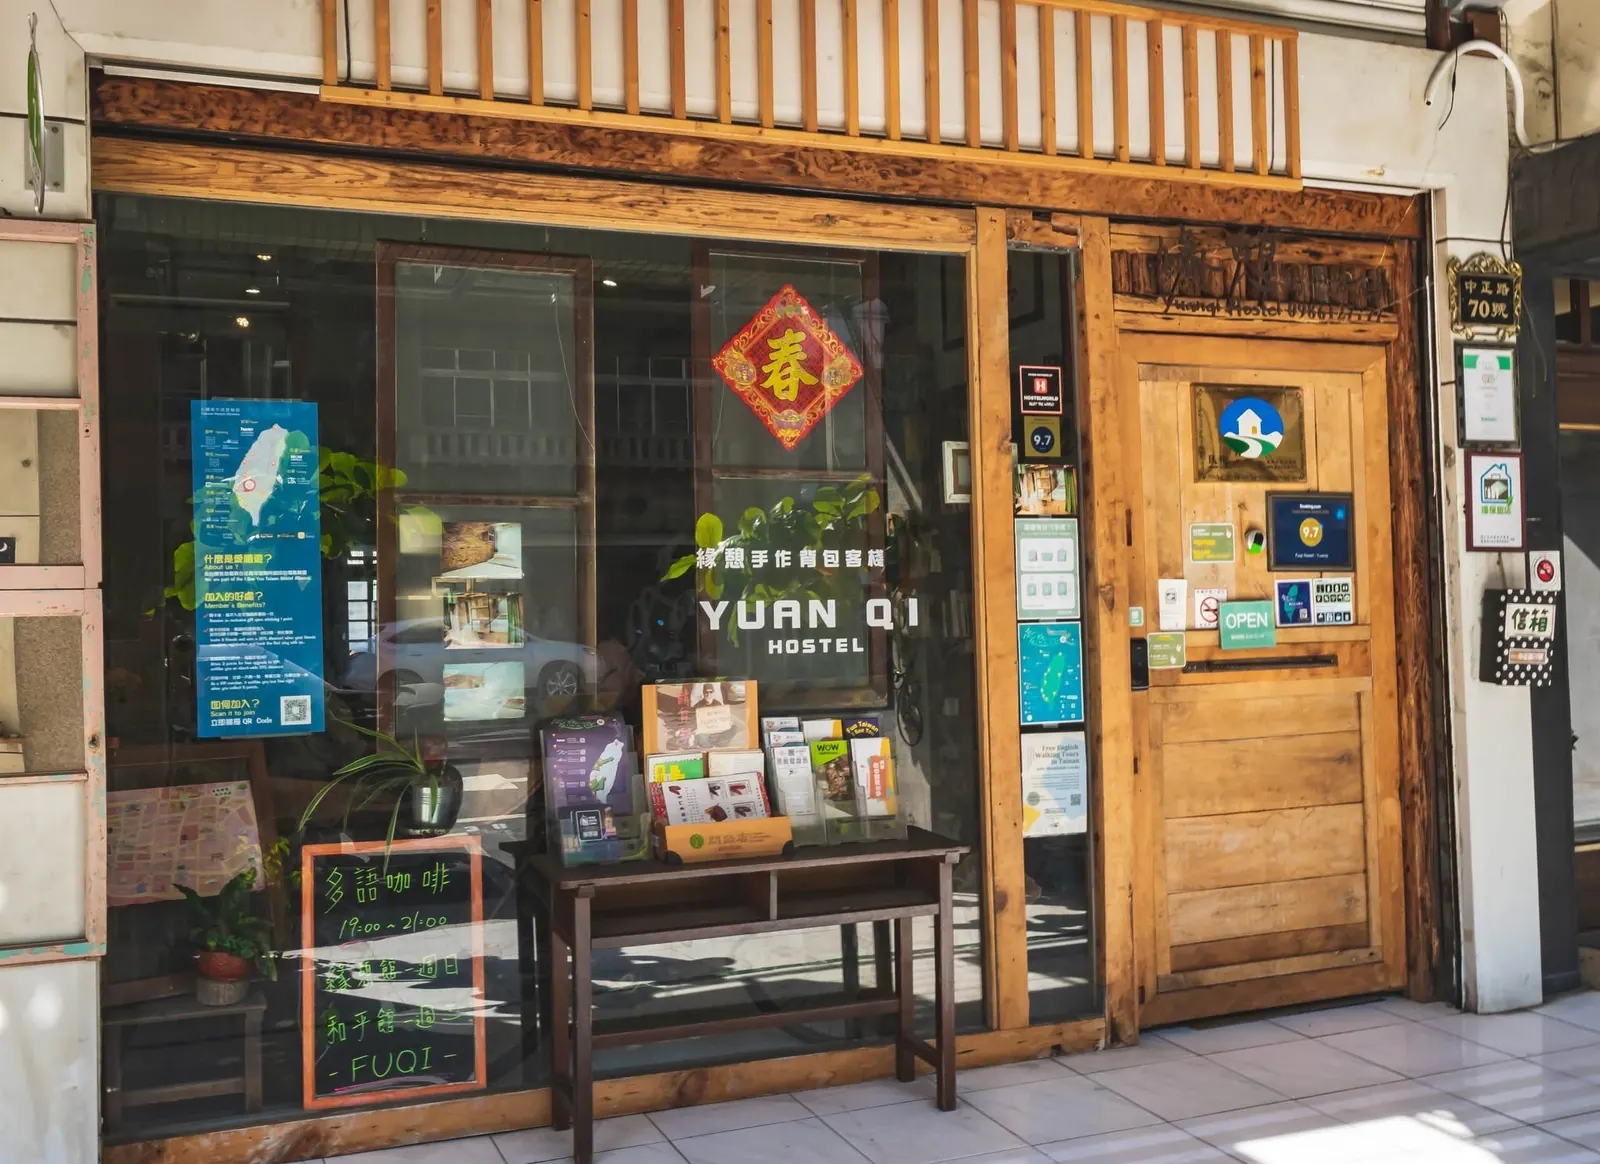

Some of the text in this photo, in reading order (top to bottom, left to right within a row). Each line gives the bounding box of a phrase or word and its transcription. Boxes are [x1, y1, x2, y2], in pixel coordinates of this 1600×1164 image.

[1464, 279, 1510, 296] 中正路
[760, 328, 819, 402] 春
[1033, 435, 1051, 446] 9.7
[696, 547, 885, 569] 緣憩手作背包客棧
[699, 598, 918, 631] YUAN QI
[1226, 612, 1269, 629] OPEN
[1511, 608, 1548, 632] 信箱
[768, 637, 864, 654] HOSTEL
[242, 717, 252, 725] QR
[256, 716, 272, 724] Code
[324, 862, 451, 914] 多語咖啡
[351, 1047, 432, 1082] FUQI
